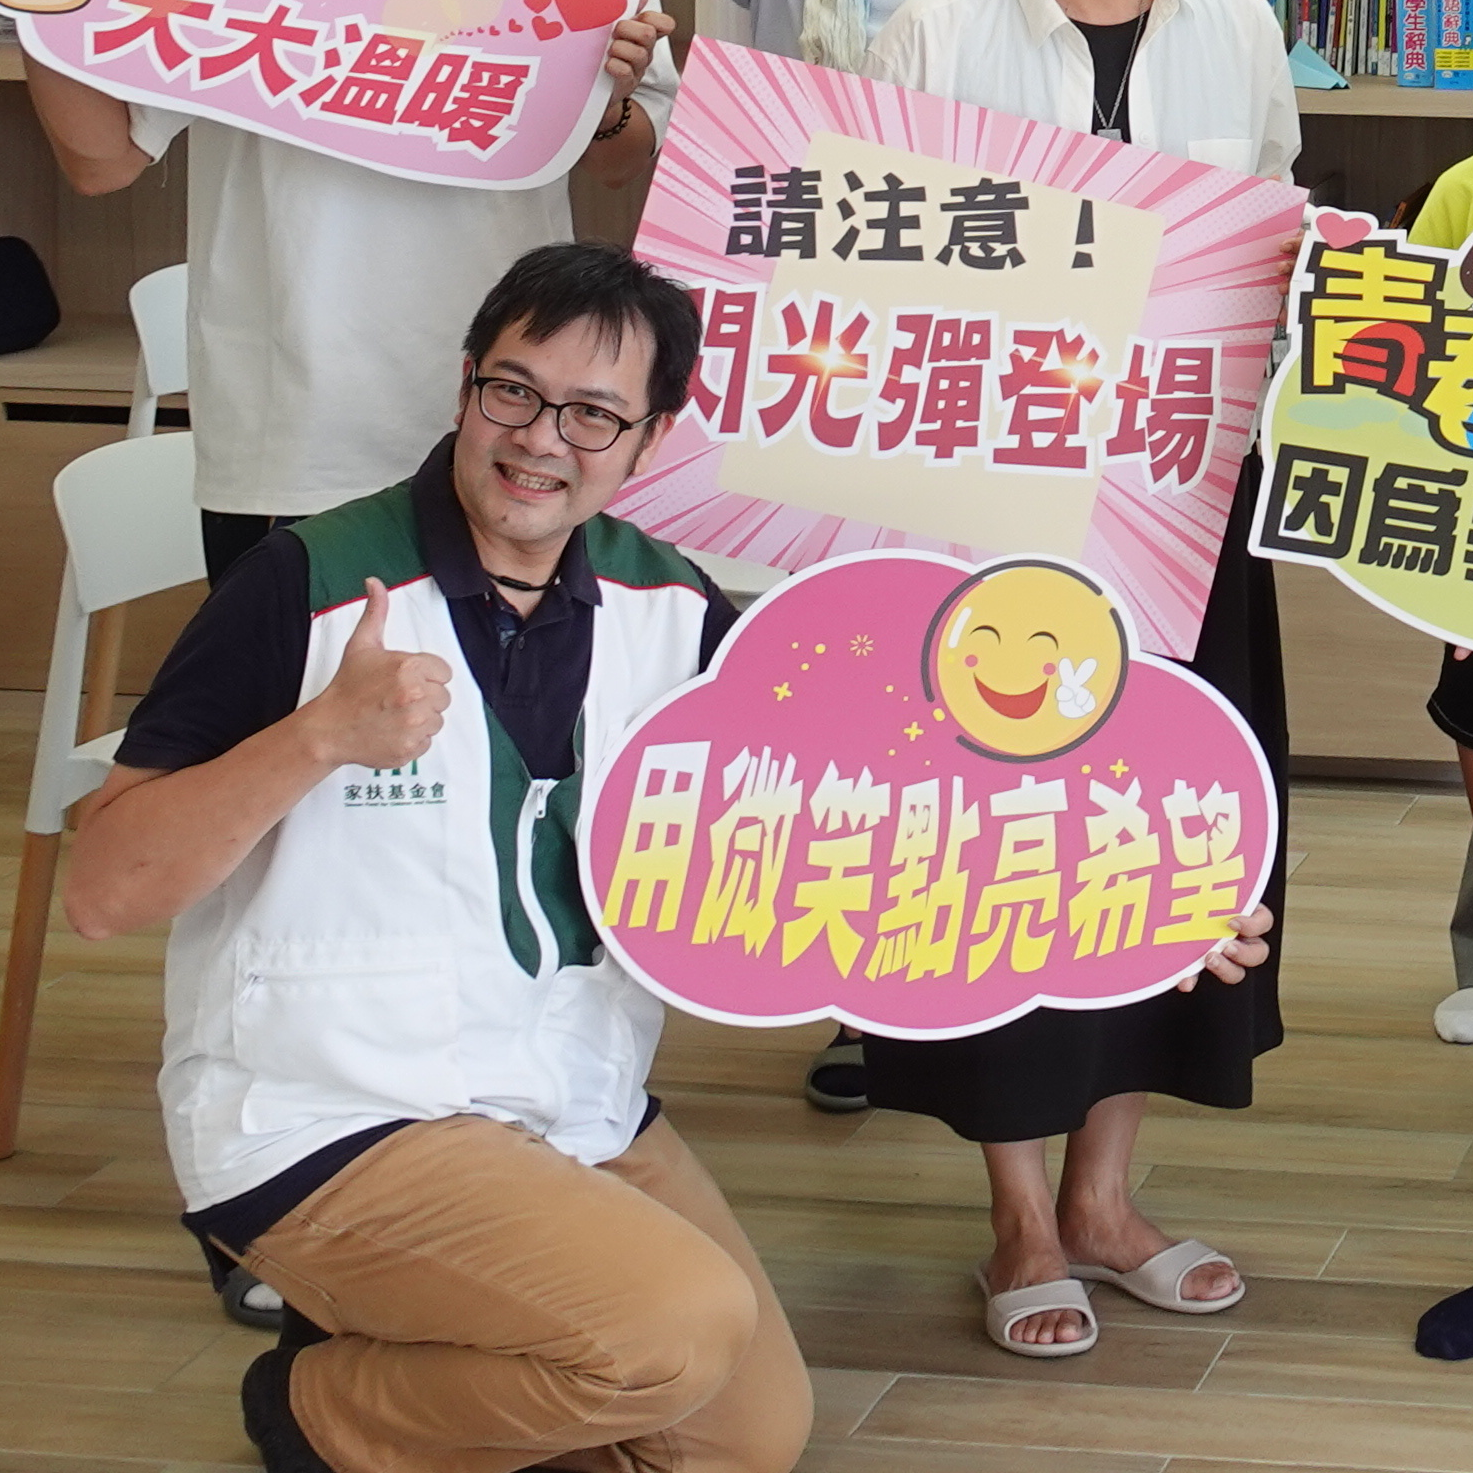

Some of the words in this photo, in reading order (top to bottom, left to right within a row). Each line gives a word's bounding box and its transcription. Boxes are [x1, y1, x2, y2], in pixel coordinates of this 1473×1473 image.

[344, 782, 445, 800] 家扶基金會
[604, 740, 1242, 983] 用微笑點亮希望
